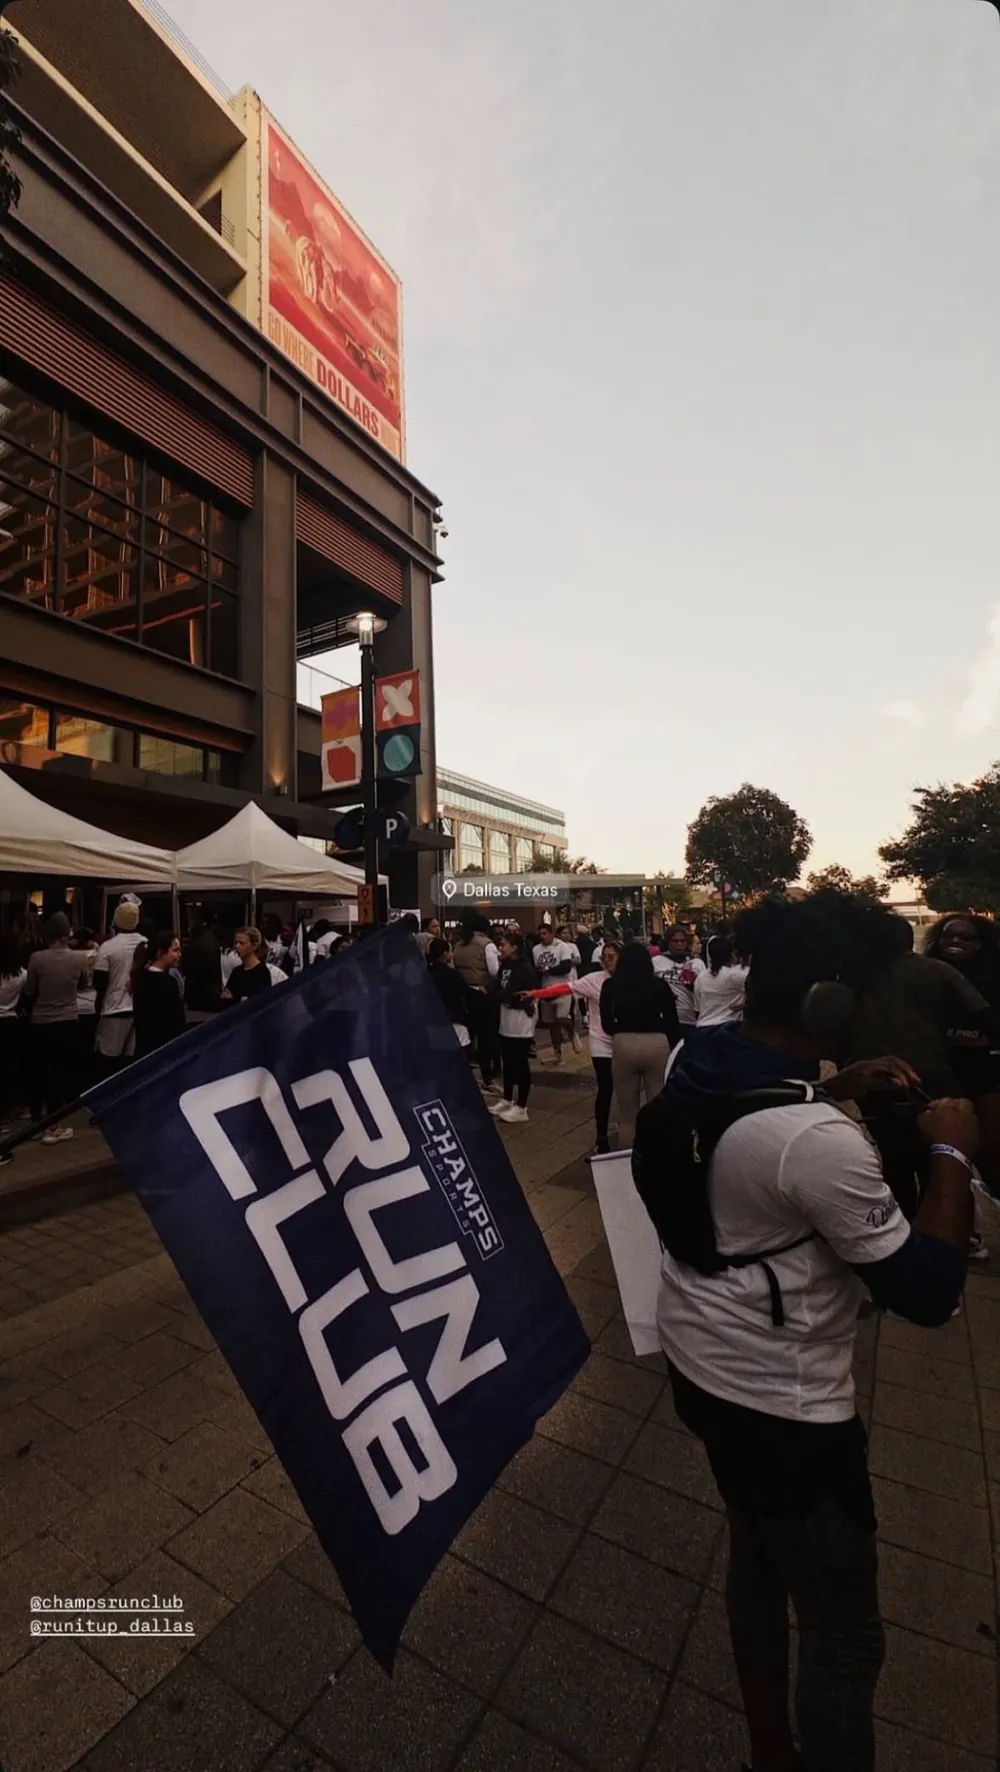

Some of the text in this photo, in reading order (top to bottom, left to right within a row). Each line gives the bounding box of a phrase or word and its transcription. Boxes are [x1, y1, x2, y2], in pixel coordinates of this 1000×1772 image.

[316, 358, 379, 437] DOLLARS
[385, 818, 398, 840] P
[291, 1056, 508, 1406] RUN
[421, 1107, 499, 1256] CHAMPS
[428, 1149, 470, 1230] SPORTS
[179, 1065, 459, 1536] CLUB
